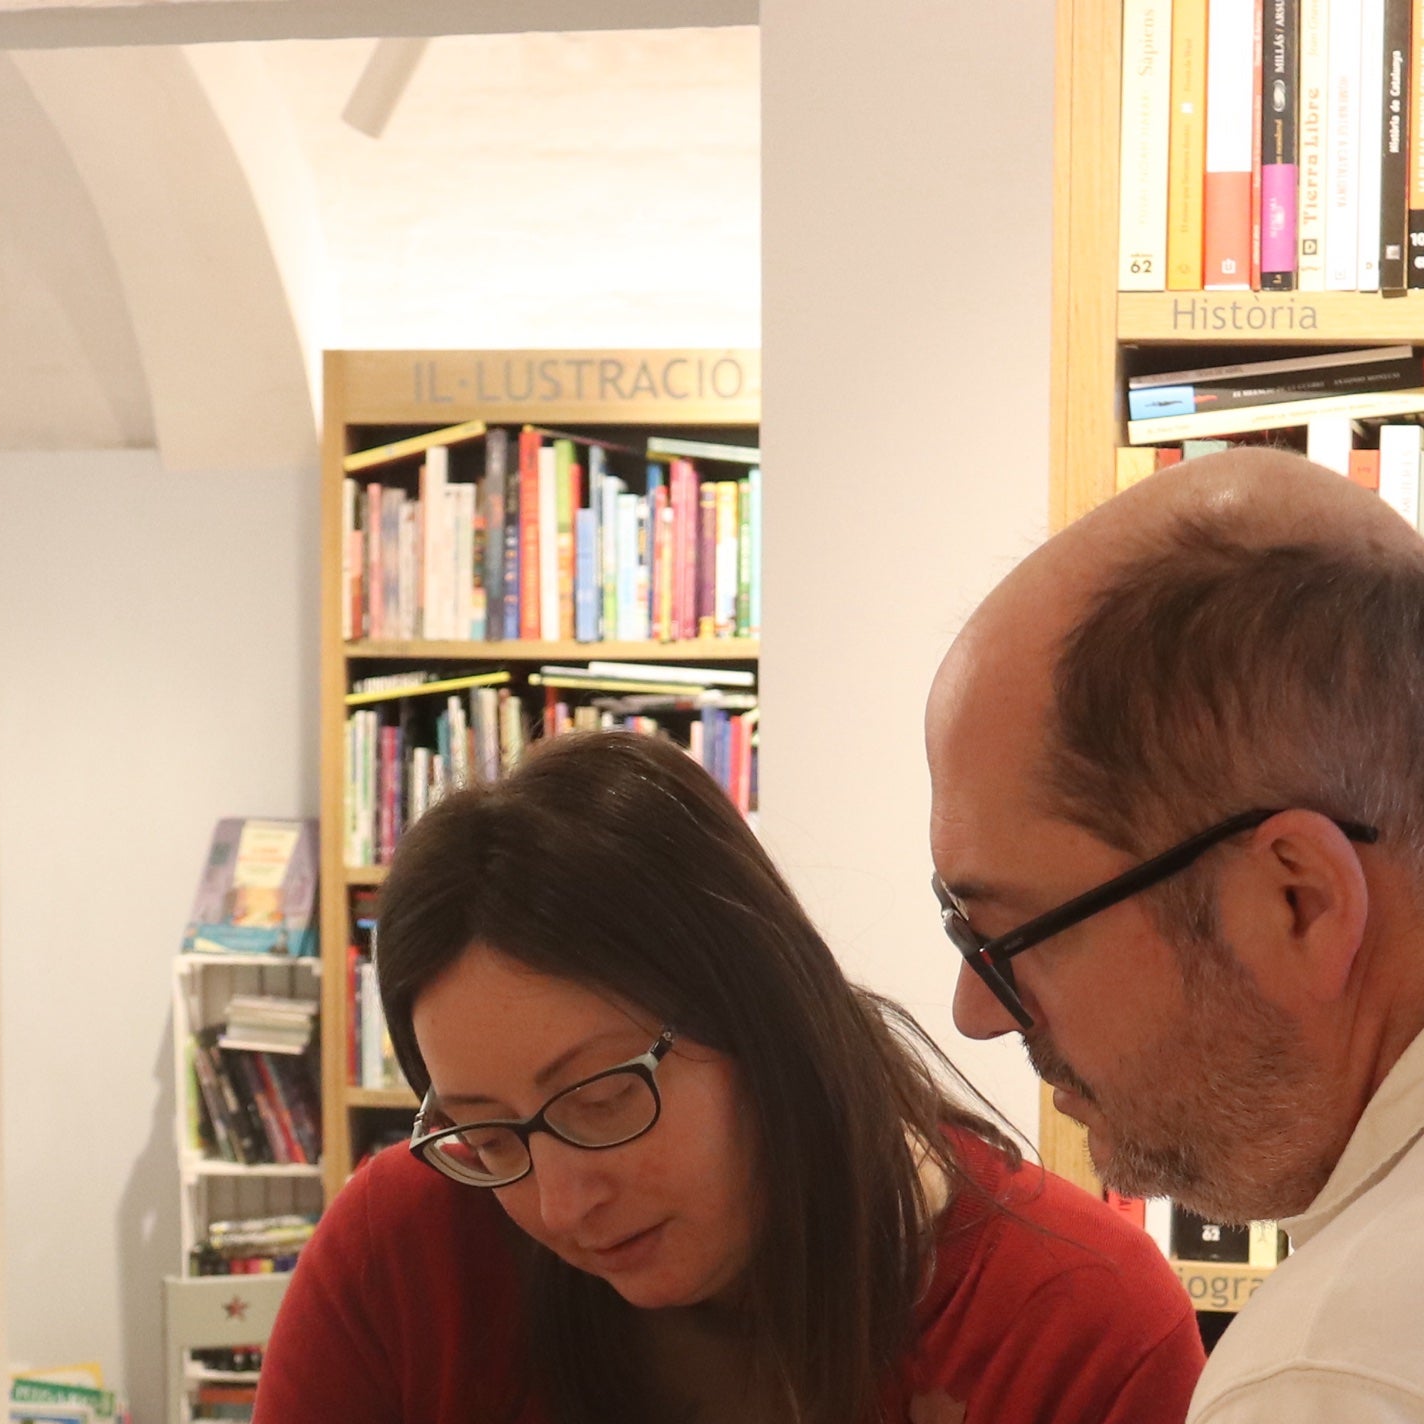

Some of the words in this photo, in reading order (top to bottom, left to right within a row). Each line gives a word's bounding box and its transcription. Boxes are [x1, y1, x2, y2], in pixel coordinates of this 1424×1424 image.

[1304, 87, 1321, 148] Libre
[1303, 155, 1320, 226] Tierra
[1129, 258, 1153, 274] 62
[1172, 296, 1319, 332] Història
